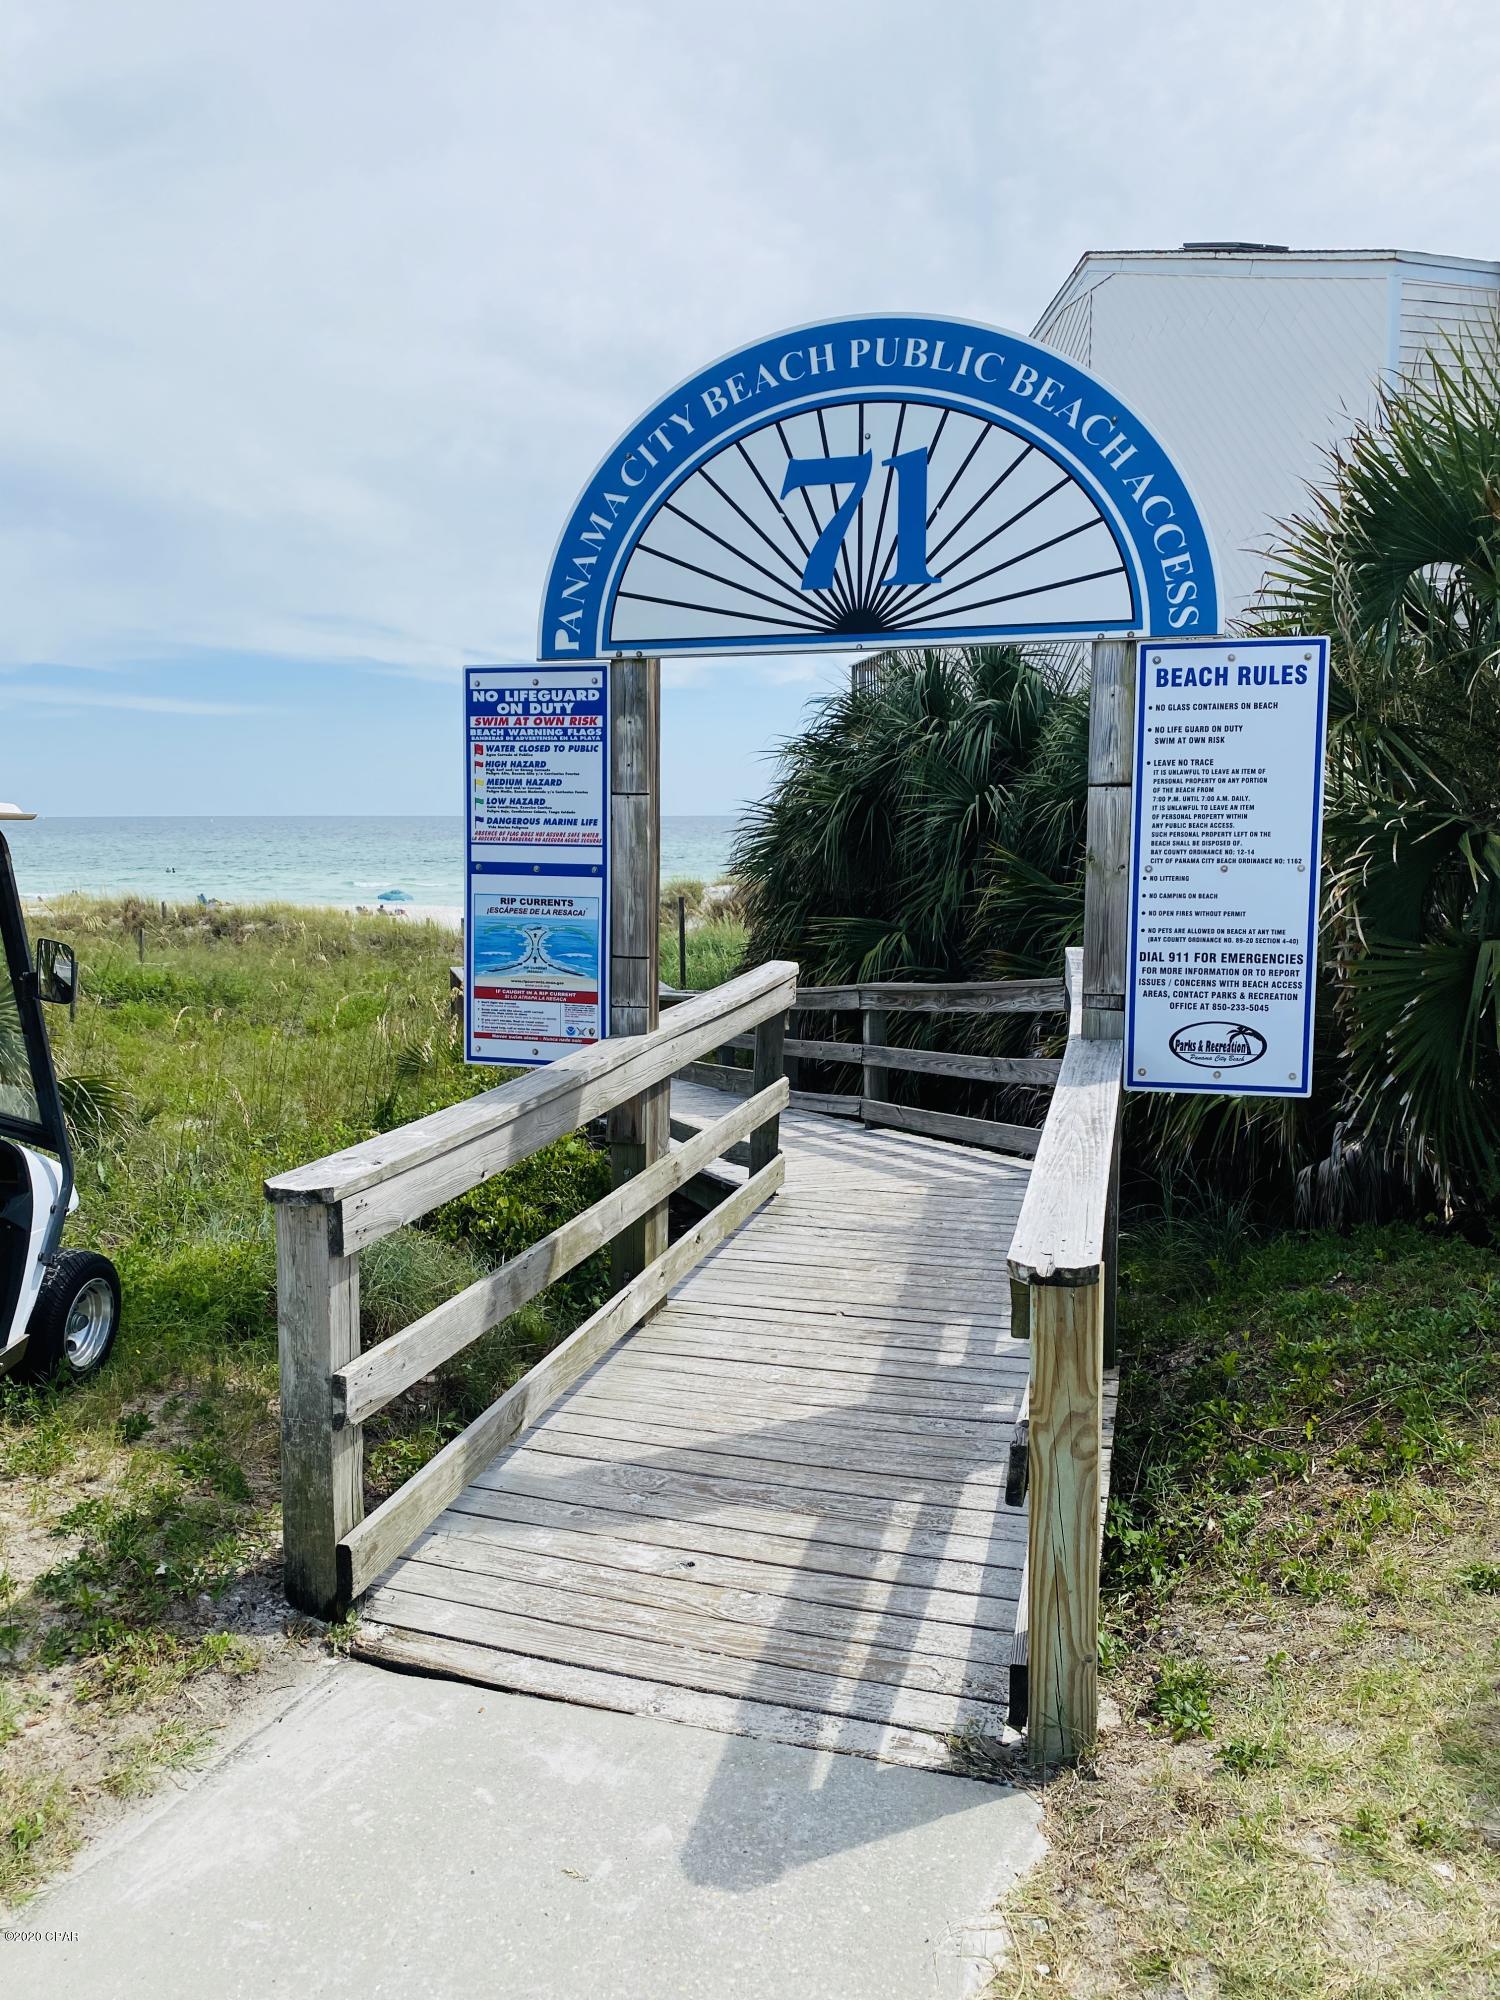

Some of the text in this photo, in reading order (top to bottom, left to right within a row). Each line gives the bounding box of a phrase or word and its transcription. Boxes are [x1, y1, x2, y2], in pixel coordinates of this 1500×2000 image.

[554, 335, 1201, 652] PANAMA CITY BEACH PUBLIC BEACH ACCESS
[779, 446, 942, 592] 71
[1156, 665, 1308, 687] BEACH RULES
[473, 690, 599, 702] NO LIFEGUARD
[497, 703, 574, 714] ON DUTY
[475, 717, 598, 726] SWIM AT OWN RISK
[519, 898, 574, 906] CURRENTS
[1139, 952, 1303, 964] DIAL 911 FOR EMERGENCIES
[1184, 968, 1239, 976] INFORMATION
[1268, 969, 1300, 977] REPORT
[1139, 978, 1303, 989] ISSUES CONCERNS WITH BEACH ACCESS
[1142, 990, 1170, 999] AREAS,
[1172, 991, 1208, 999] CONTACT
[1211, 991, 1236, 1000] PARKS
[1248, 992, 1298, 1000] RECREATION
[1169, 1002, 1197, 1010] OFFICE
[1212, 1003, 1269, 1011] 850-233-5045
[1175, 1039, 1246, 1053] Parks & Recreation
